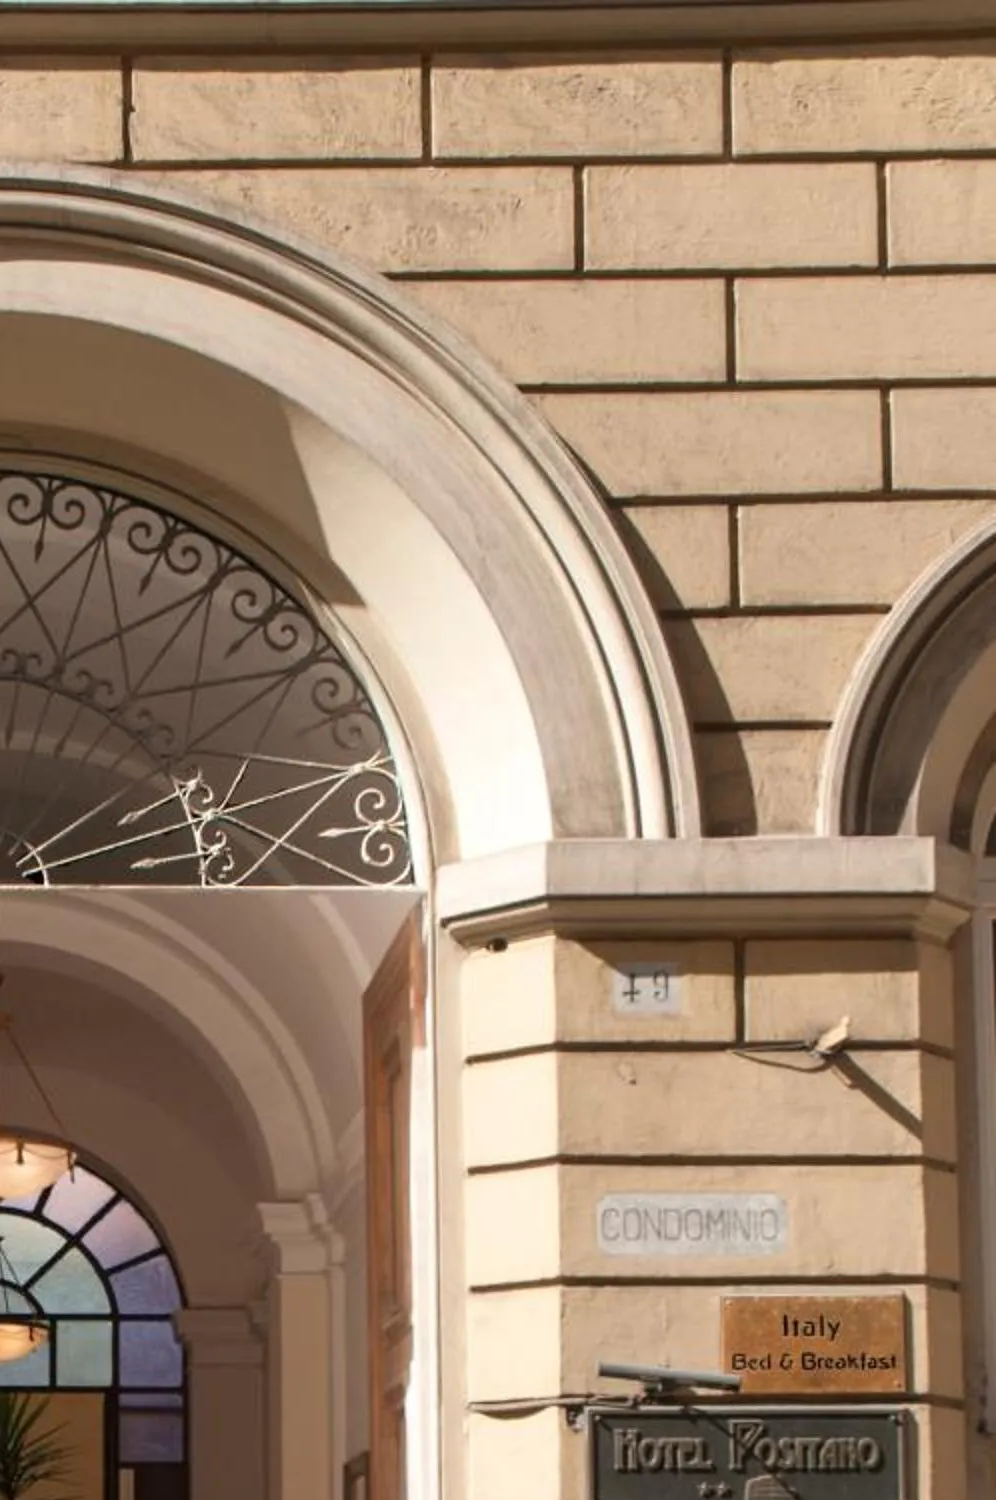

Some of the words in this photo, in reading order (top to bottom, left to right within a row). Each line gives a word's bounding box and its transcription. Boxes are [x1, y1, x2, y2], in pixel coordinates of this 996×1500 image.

[600, 1207, 781, 1242] CONDOMINIO
[782, 1313, 841, 1341] Italy
[731, 1352, 772, 1371] Bed
[779, 1352, 794, 1371] &
[800, 1351, 897, 1372] Breakfast
[612, 1427, 714, 1471] HOTEL
[727, 1418, 882, 1471] POSITANO
